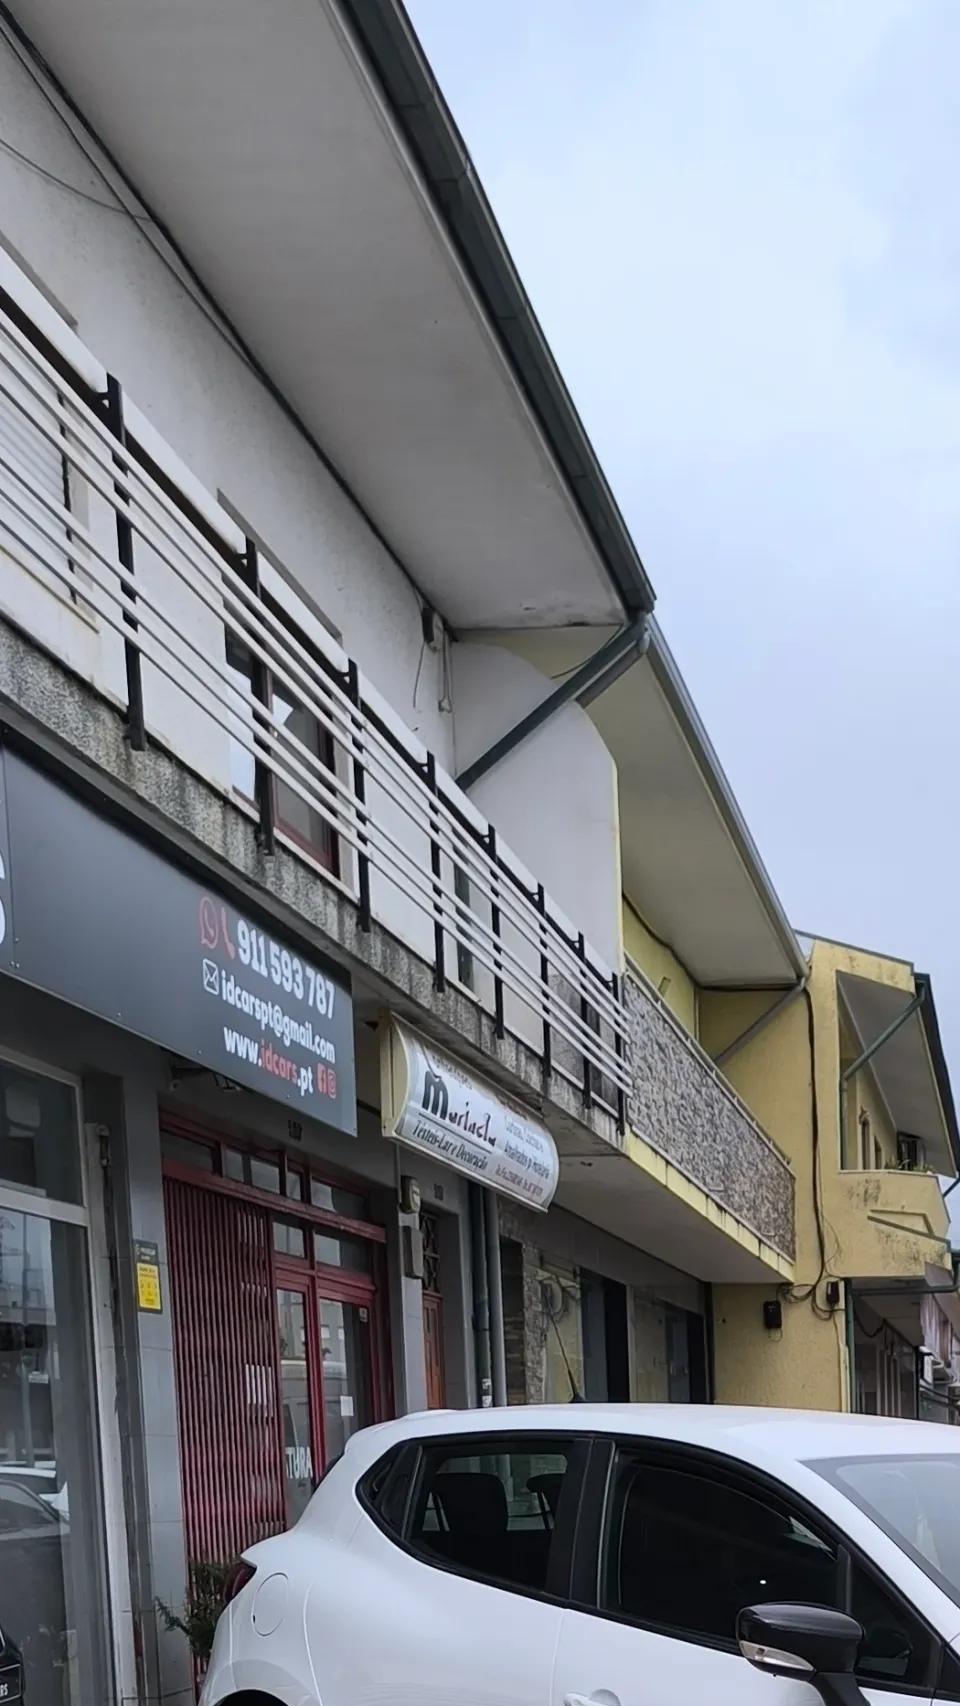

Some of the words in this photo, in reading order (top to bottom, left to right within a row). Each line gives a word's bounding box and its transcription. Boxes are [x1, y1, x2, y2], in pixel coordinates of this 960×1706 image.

[220, 969, 336, 1064] idcarspt@gmail.com
[237, 919, 268, 978] 911
[269, 941, 304, 1000] 593
[305, 966, 335, 1020] 787
[223, 1026, 314, 1097] www.idcars.pt
